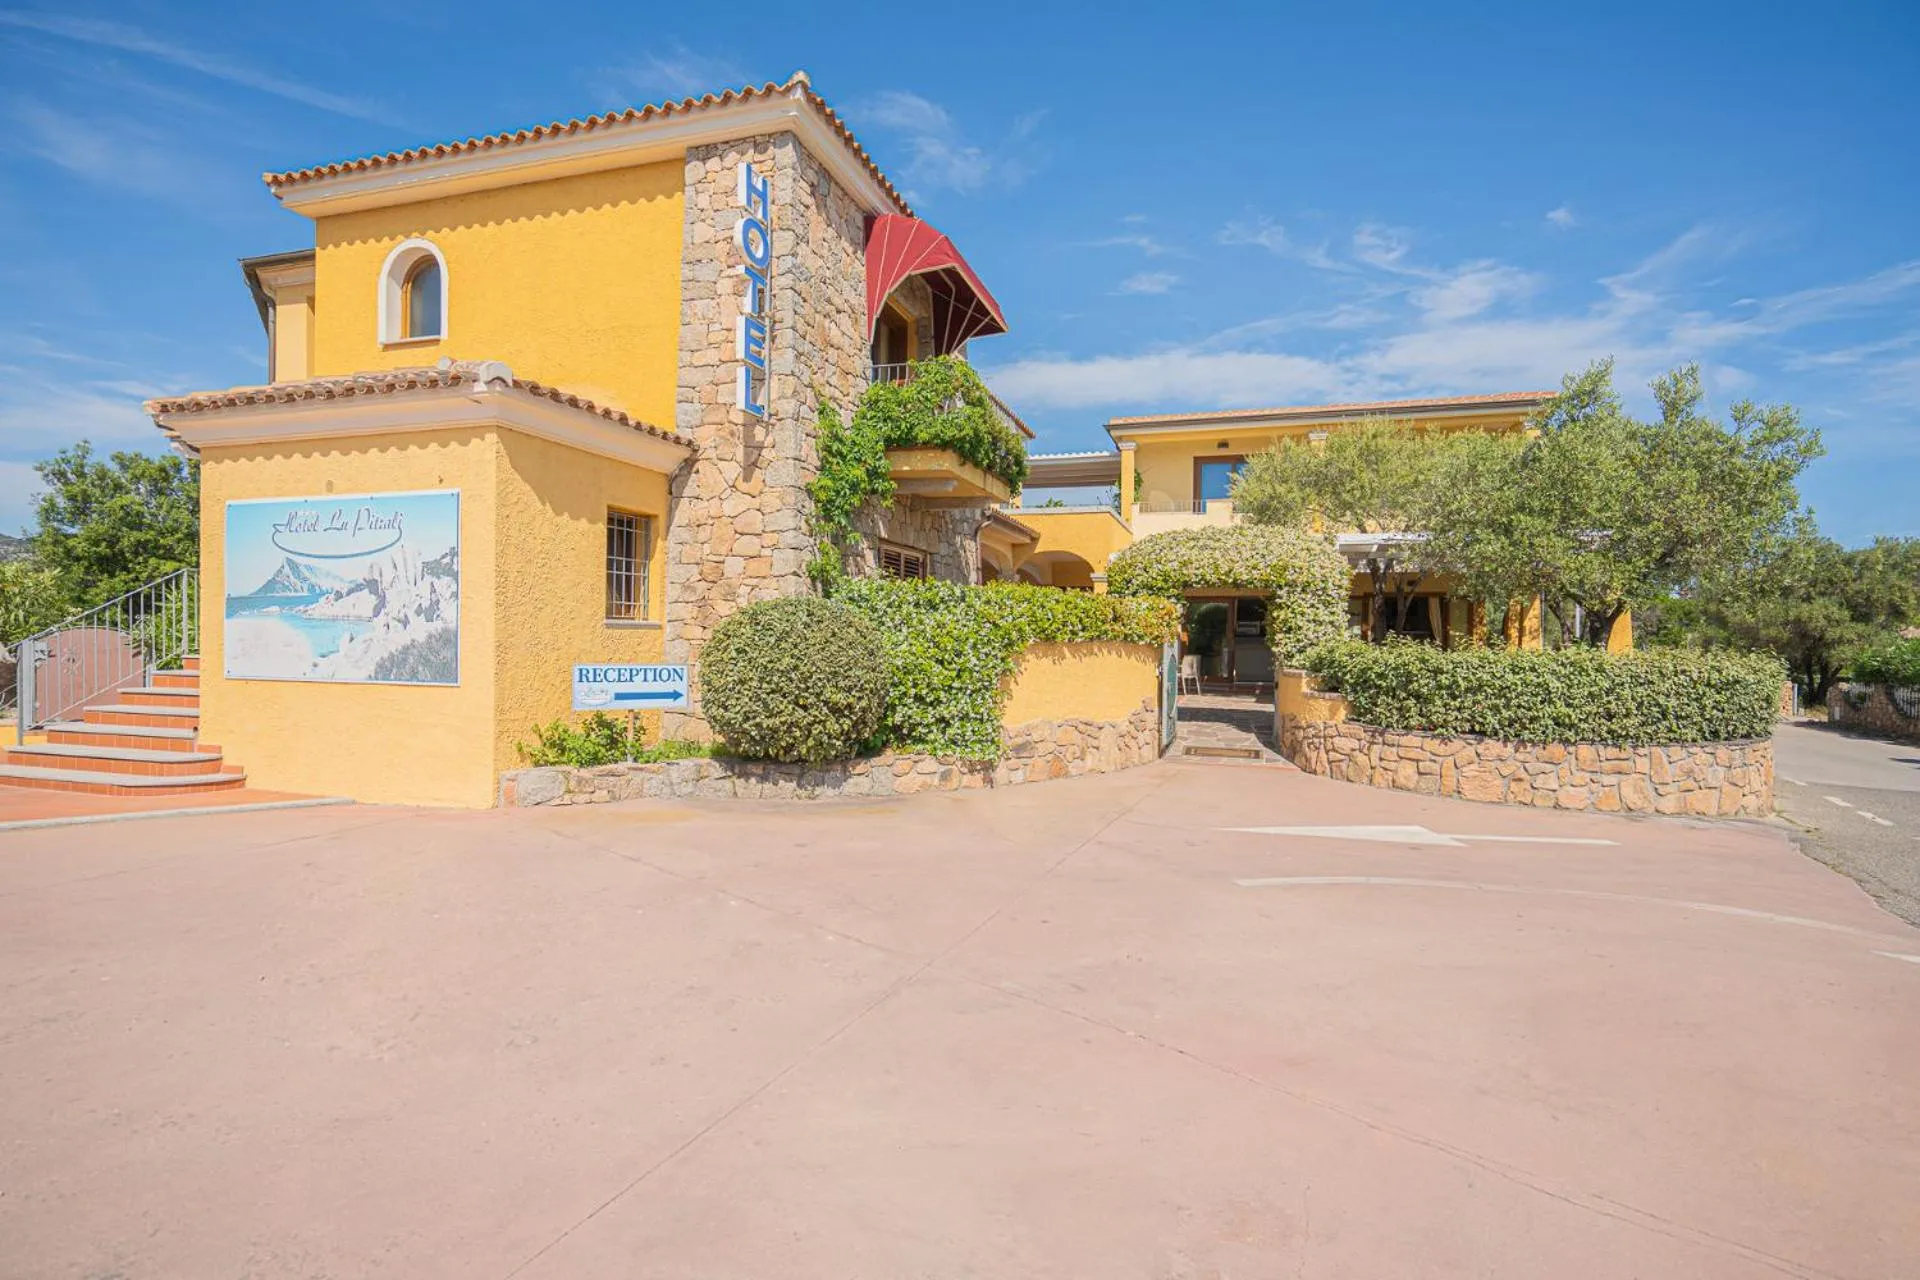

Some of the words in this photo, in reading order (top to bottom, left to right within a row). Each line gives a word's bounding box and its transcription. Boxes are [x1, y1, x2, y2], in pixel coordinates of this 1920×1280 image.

[735, 161, 771, 417] HOTEL
[273, 511, 320, 533] Hotel
[577, 667, 684, 683] RECEPTION
